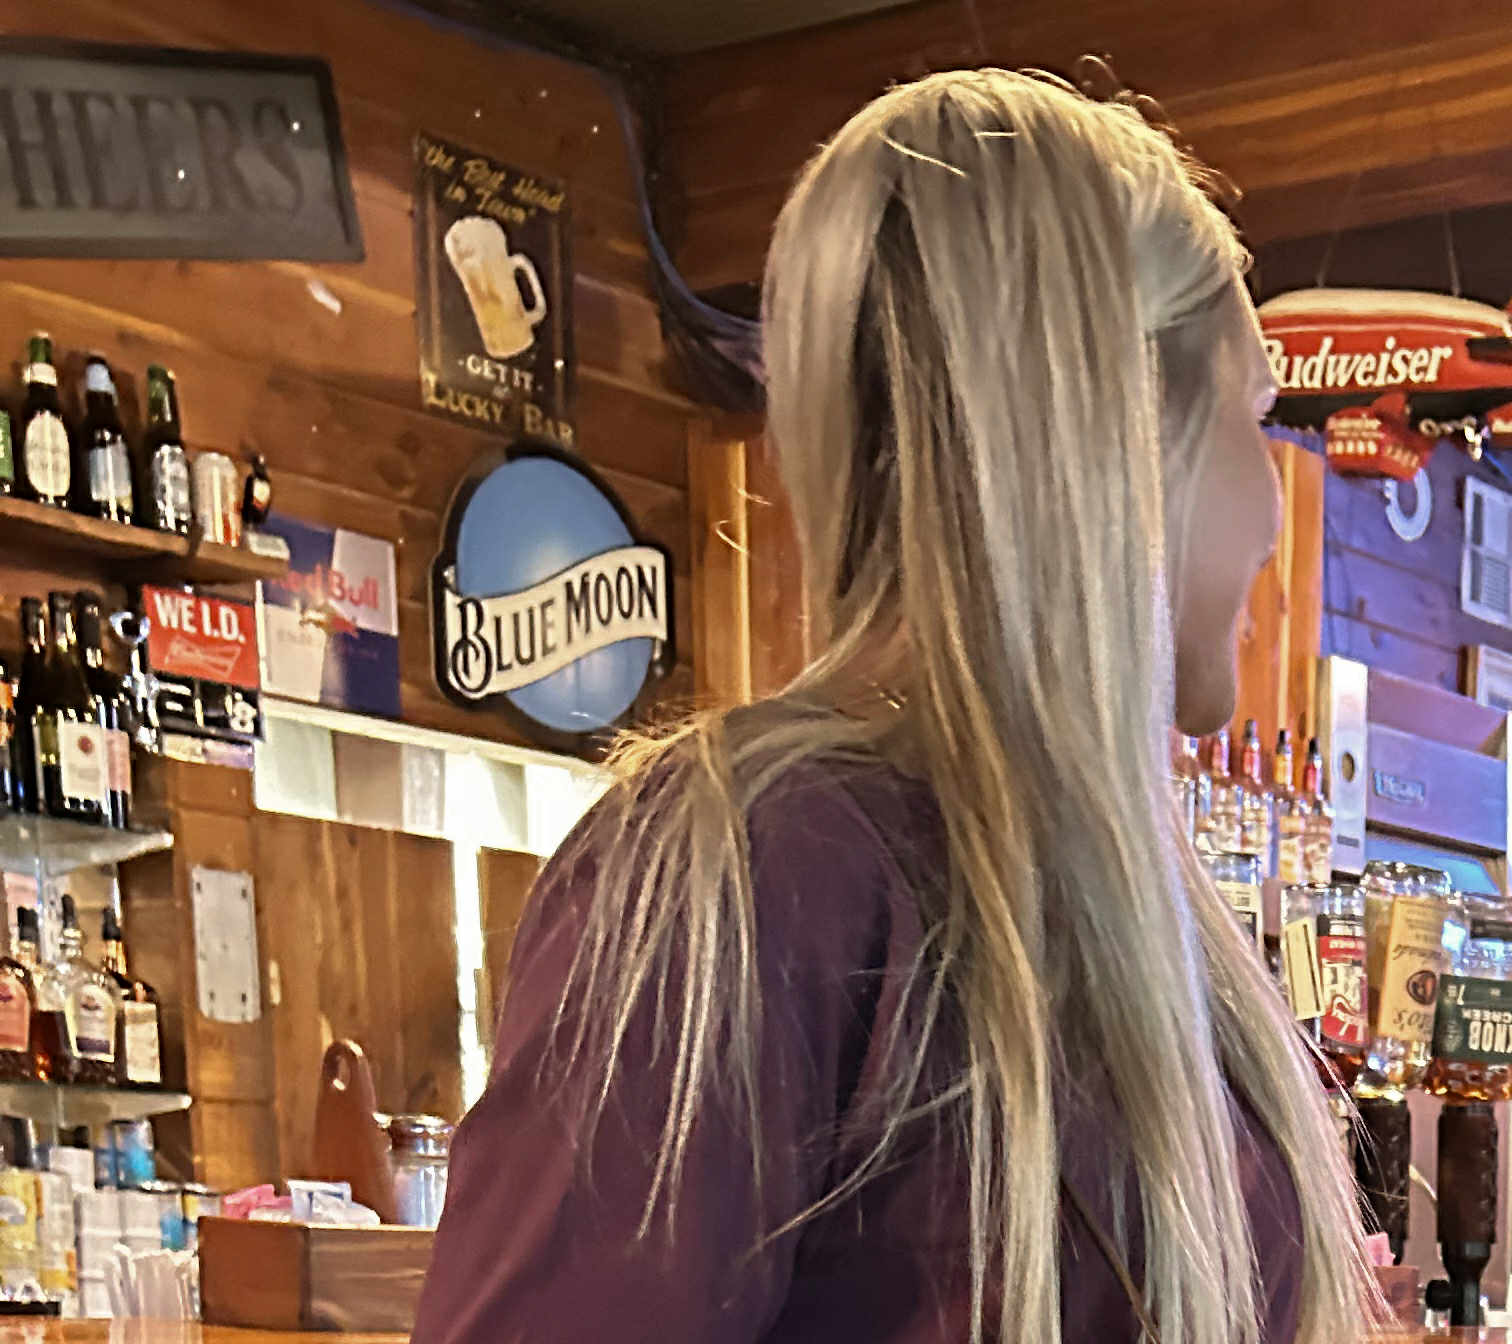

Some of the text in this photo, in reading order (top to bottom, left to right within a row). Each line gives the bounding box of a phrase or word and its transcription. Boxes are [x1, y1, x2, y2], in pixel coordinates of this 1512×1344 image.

[466, 353, 507, 384] GET
[328, 568, 380, 609] Bull
[153, 591, 199, 633] WE
[201, 604, 247, 644] I.D.
[452, 565, 659, 693] BLUE MOON
